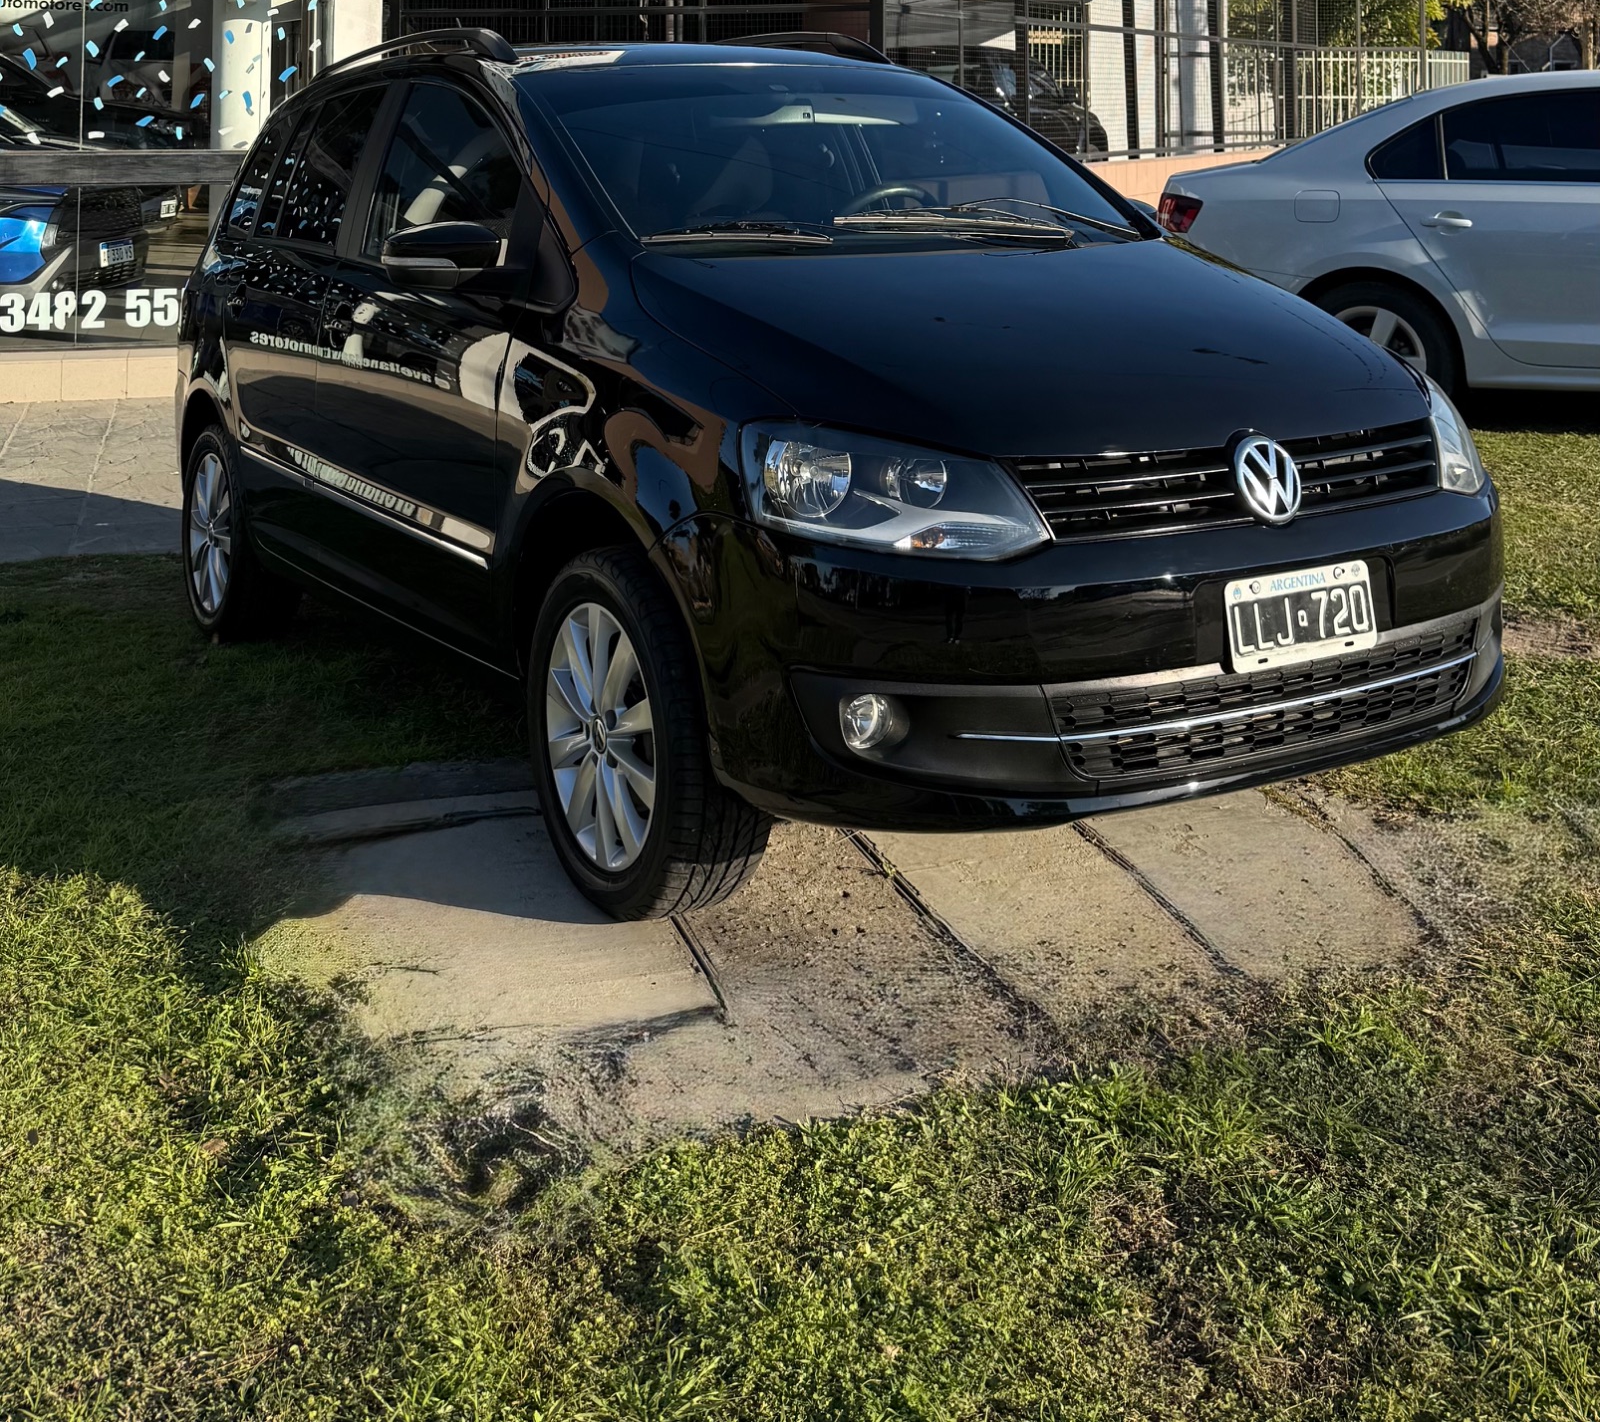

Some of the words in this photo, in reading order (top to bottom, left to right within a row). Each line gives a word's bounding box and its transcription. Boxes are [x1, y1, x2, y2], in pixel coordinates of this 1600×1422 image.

[0, 290, 107, 333] 3482
[125, 288, 185, 328] 55
[1270, 572, 1326, 592] ARGENTINA
